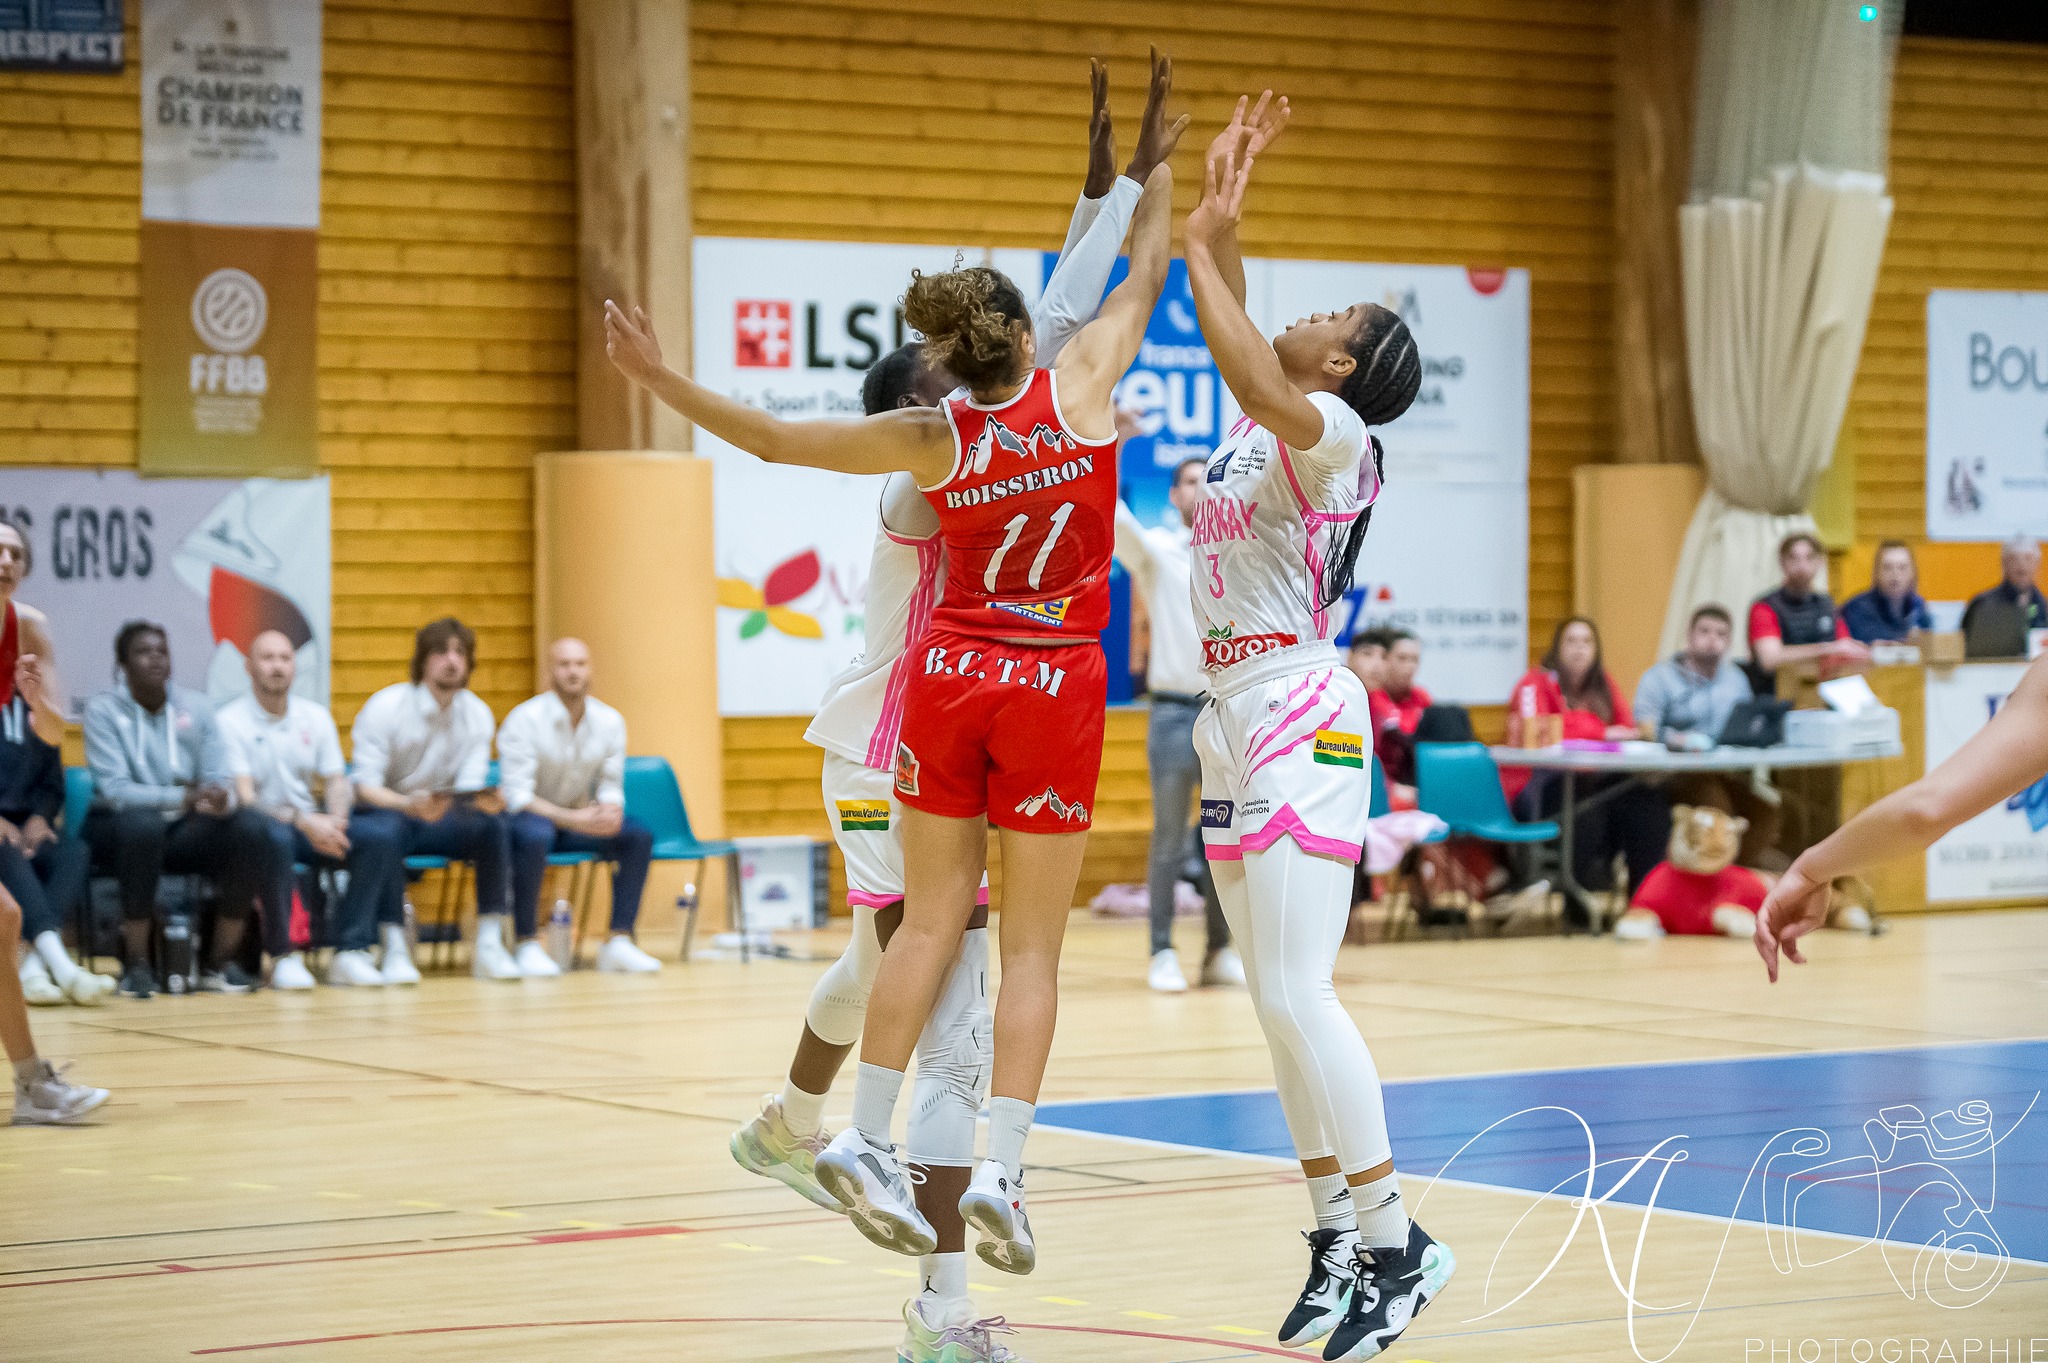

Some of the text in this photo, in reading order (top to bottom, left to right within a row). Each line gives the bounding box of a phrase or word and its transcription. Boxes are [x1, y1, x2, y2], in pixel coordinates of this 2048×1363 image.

[157, 76, 304, 106] CHAMPION
[156, 102, 304, 134] DE FRANCE
[189, 353, 267, 394] FFBB
[1117, 369, 1215, 437] eu
[944, 454, 1094, 509] BOISSERON
[52, 504, 154, 580] GROS
[983, 501, 1075, 594] 11
[1206, 553, 1225, 599] 3
[1004, 606, 1062, 627] ARTEMENT
[1315, 739, 1342, 752] Bureau
